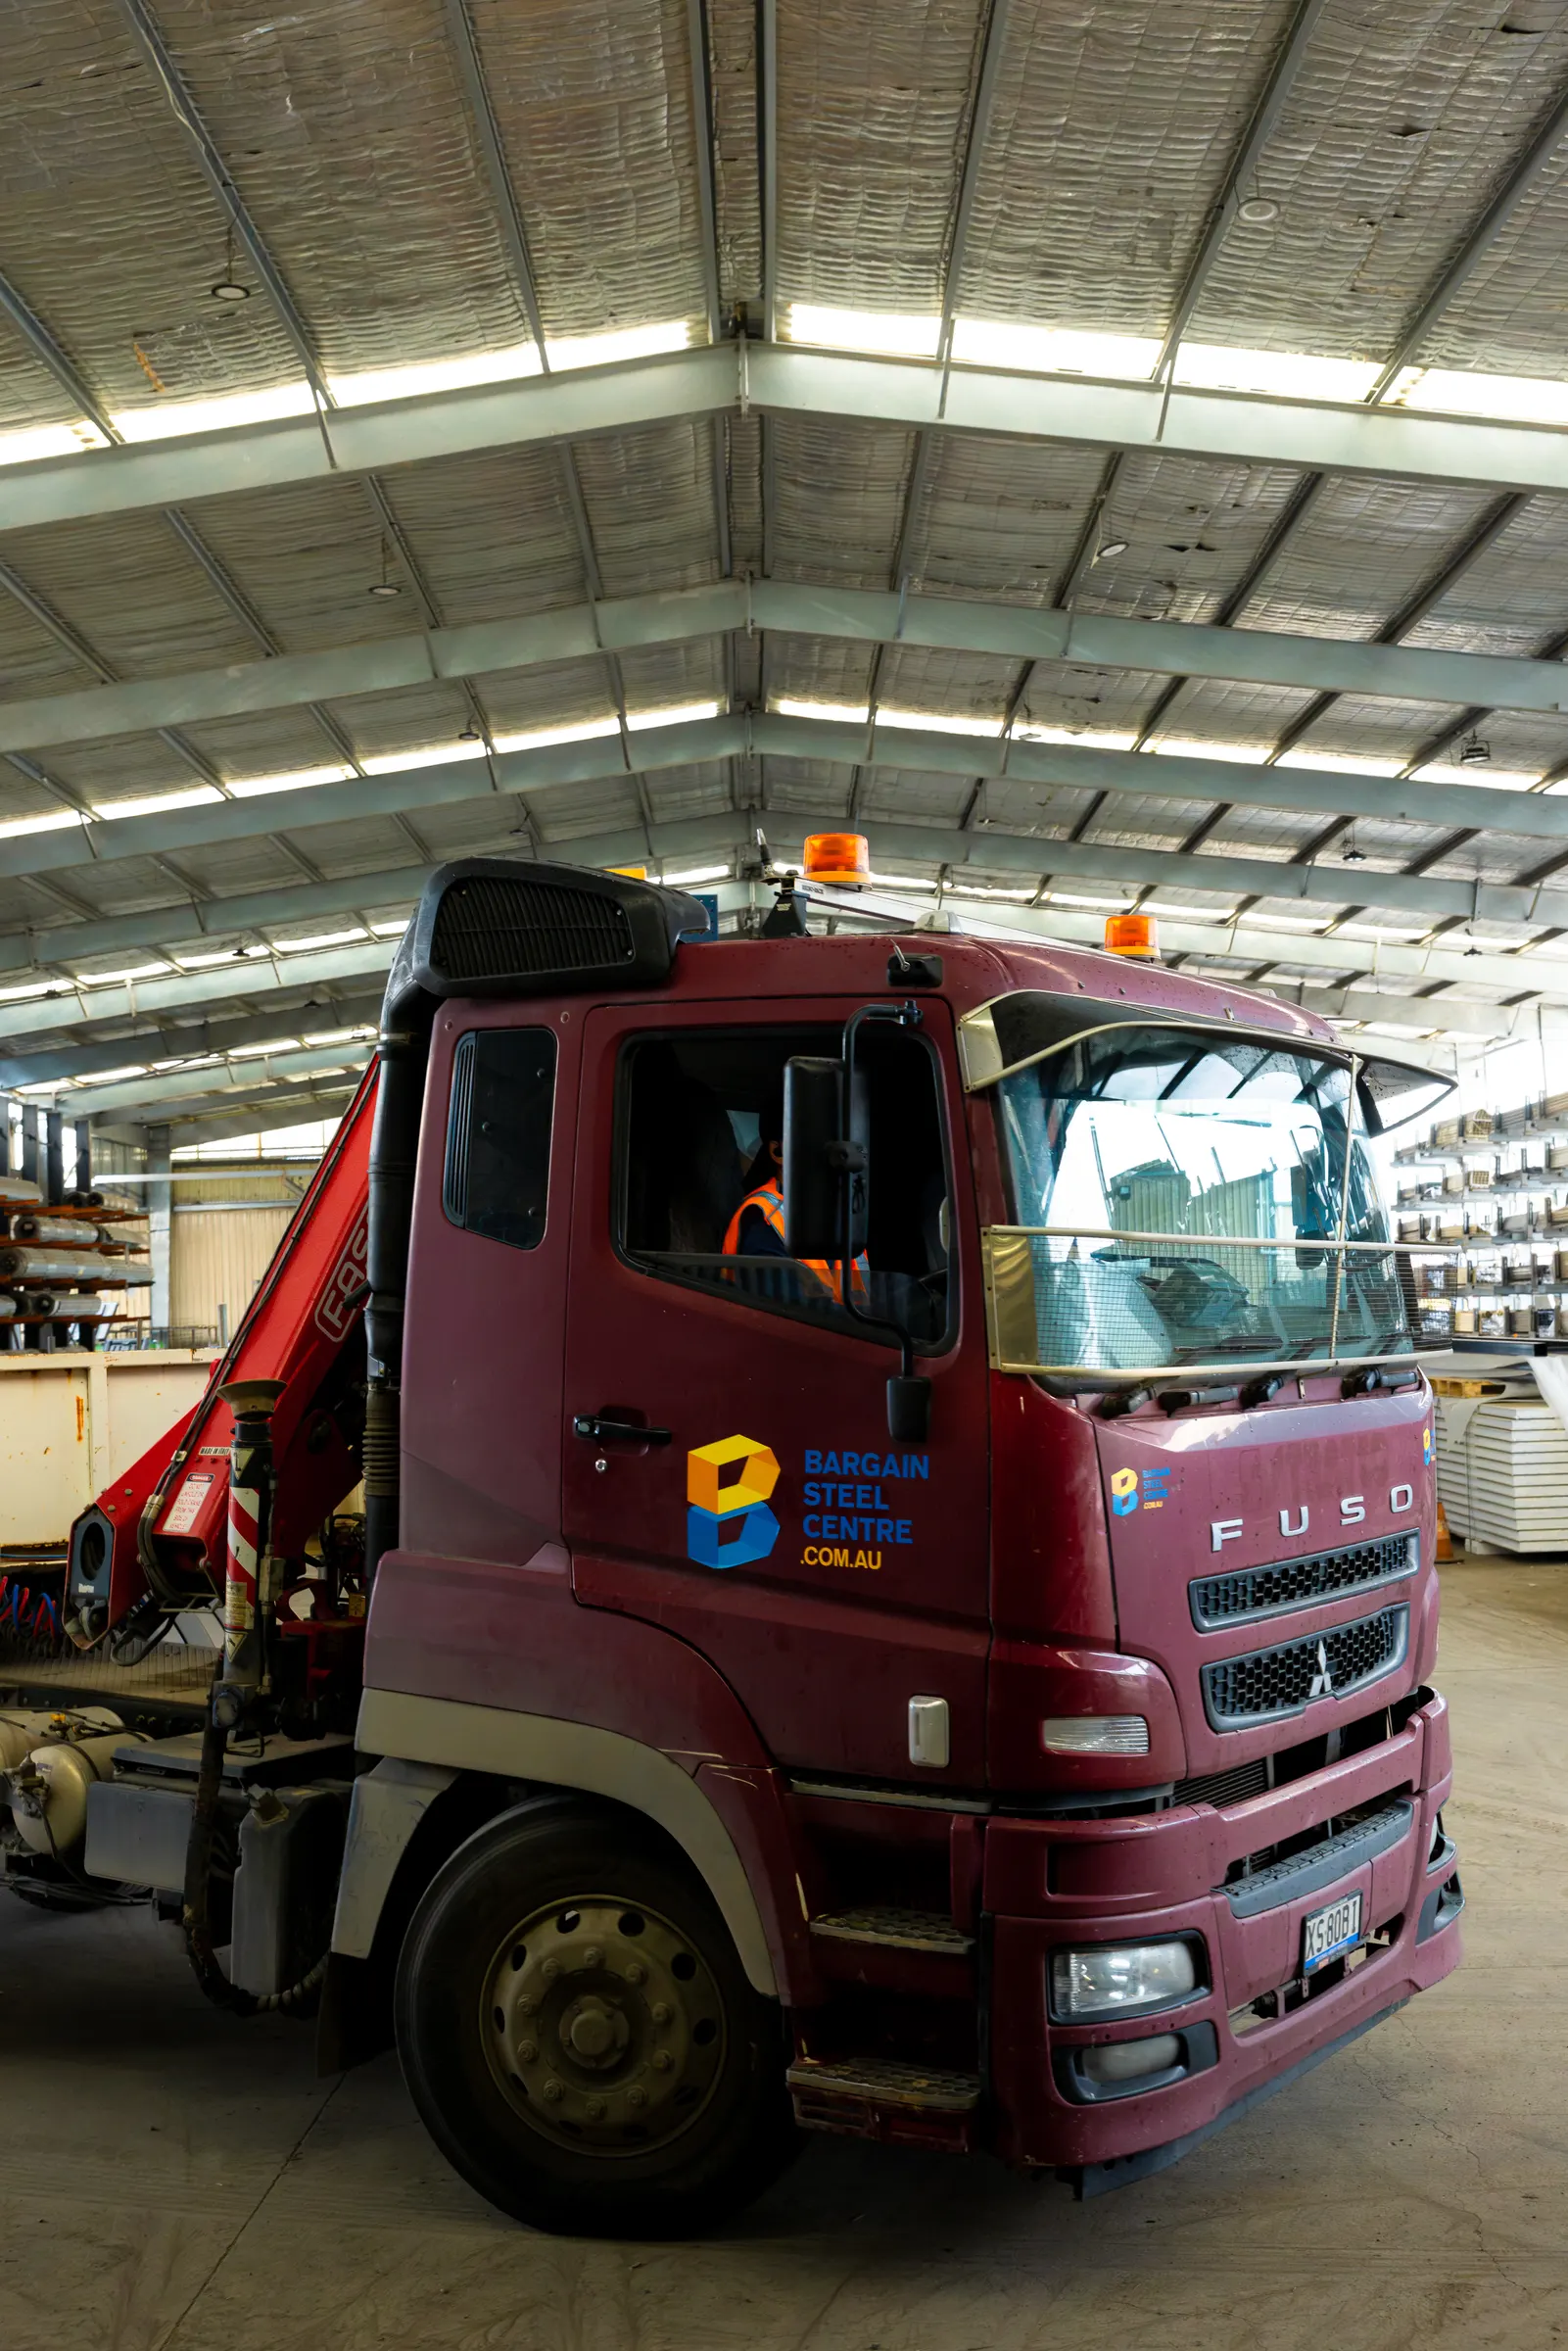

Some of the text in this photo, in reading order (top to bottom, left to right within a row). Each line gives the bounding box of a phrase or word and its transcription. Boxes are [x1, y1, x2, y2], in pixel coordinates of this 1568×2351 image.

[804, 1450, 929, 1479] BARGAIN
[803, 1481, 889, 1510] STEEL
[802, 1513, 914, 1544] CENTRE
[1211, 1484, 1413, 1553] FUSO
[800, 1546, 881, 1570] .COM.AU
